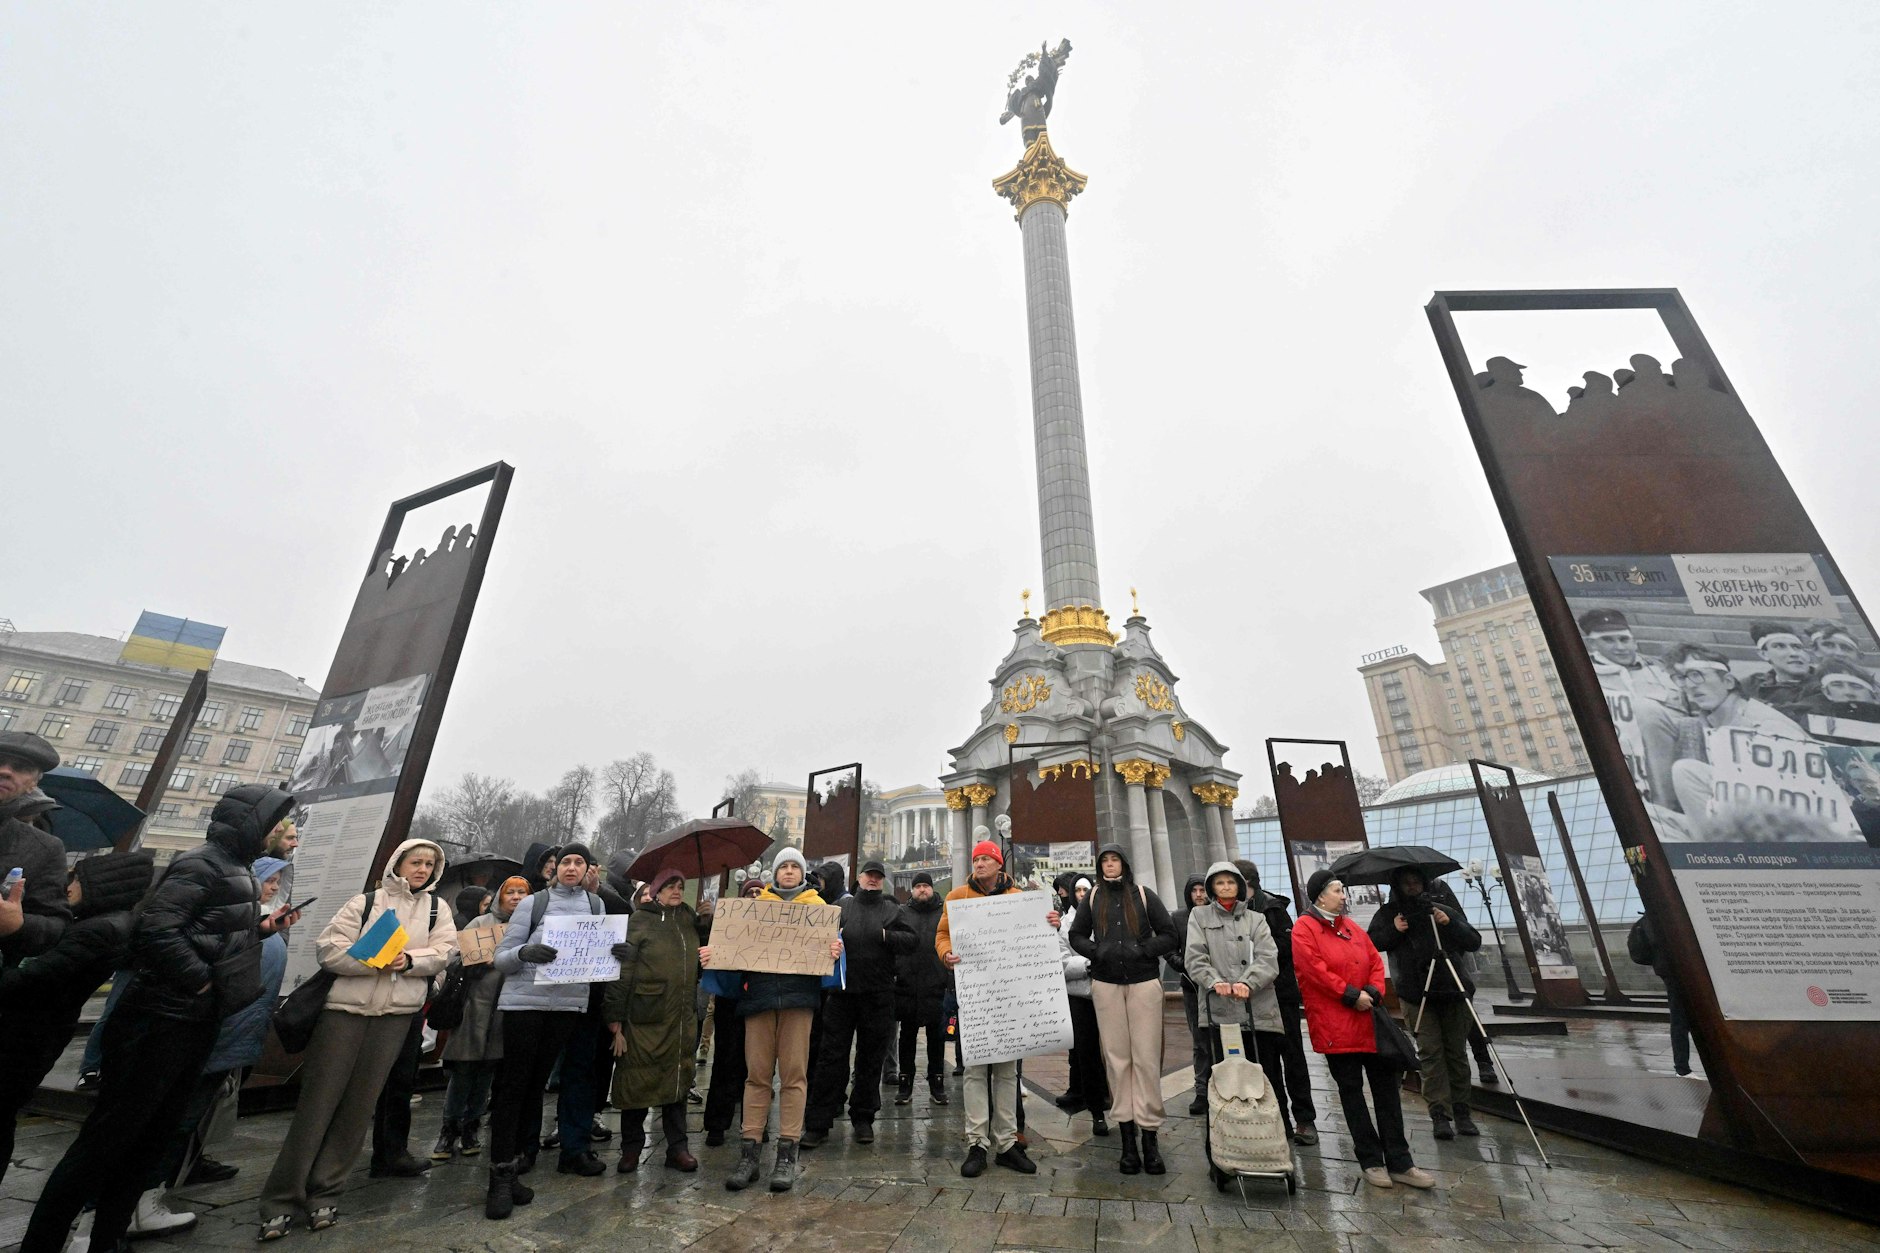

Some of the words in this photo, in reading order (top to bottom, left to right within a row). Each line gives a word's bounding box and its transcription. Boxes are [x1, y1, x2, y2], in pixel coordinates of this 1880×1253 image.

[1570, 564, 1594, 582] 35
[1696, 580, 1768, 594] ЖОВТЕНЬ
[1770, 580, 1817, 592] 90-ГО
[1704, 594, 1744, 608] ВИБІР
[1750, 594, 1822, 609] МОЛОДИХ
[1361, 644, 1408, 664] ГОТЕЛЬ
[1686, 853, 1732, 864] Пов'язка
[1732, 853, 1746, 864] «Я
[1748, 855, 1798, 866] голодую»
[715, 900, 840, 928] ЗРАДНИКАМ
[548, 930, 598, 939] ВИБОРАМ
[604, 931, 616, 940] ТА
[574, 948, 590, 957] НІ
[544, 968, 588, 976] ЗАКОНУ
